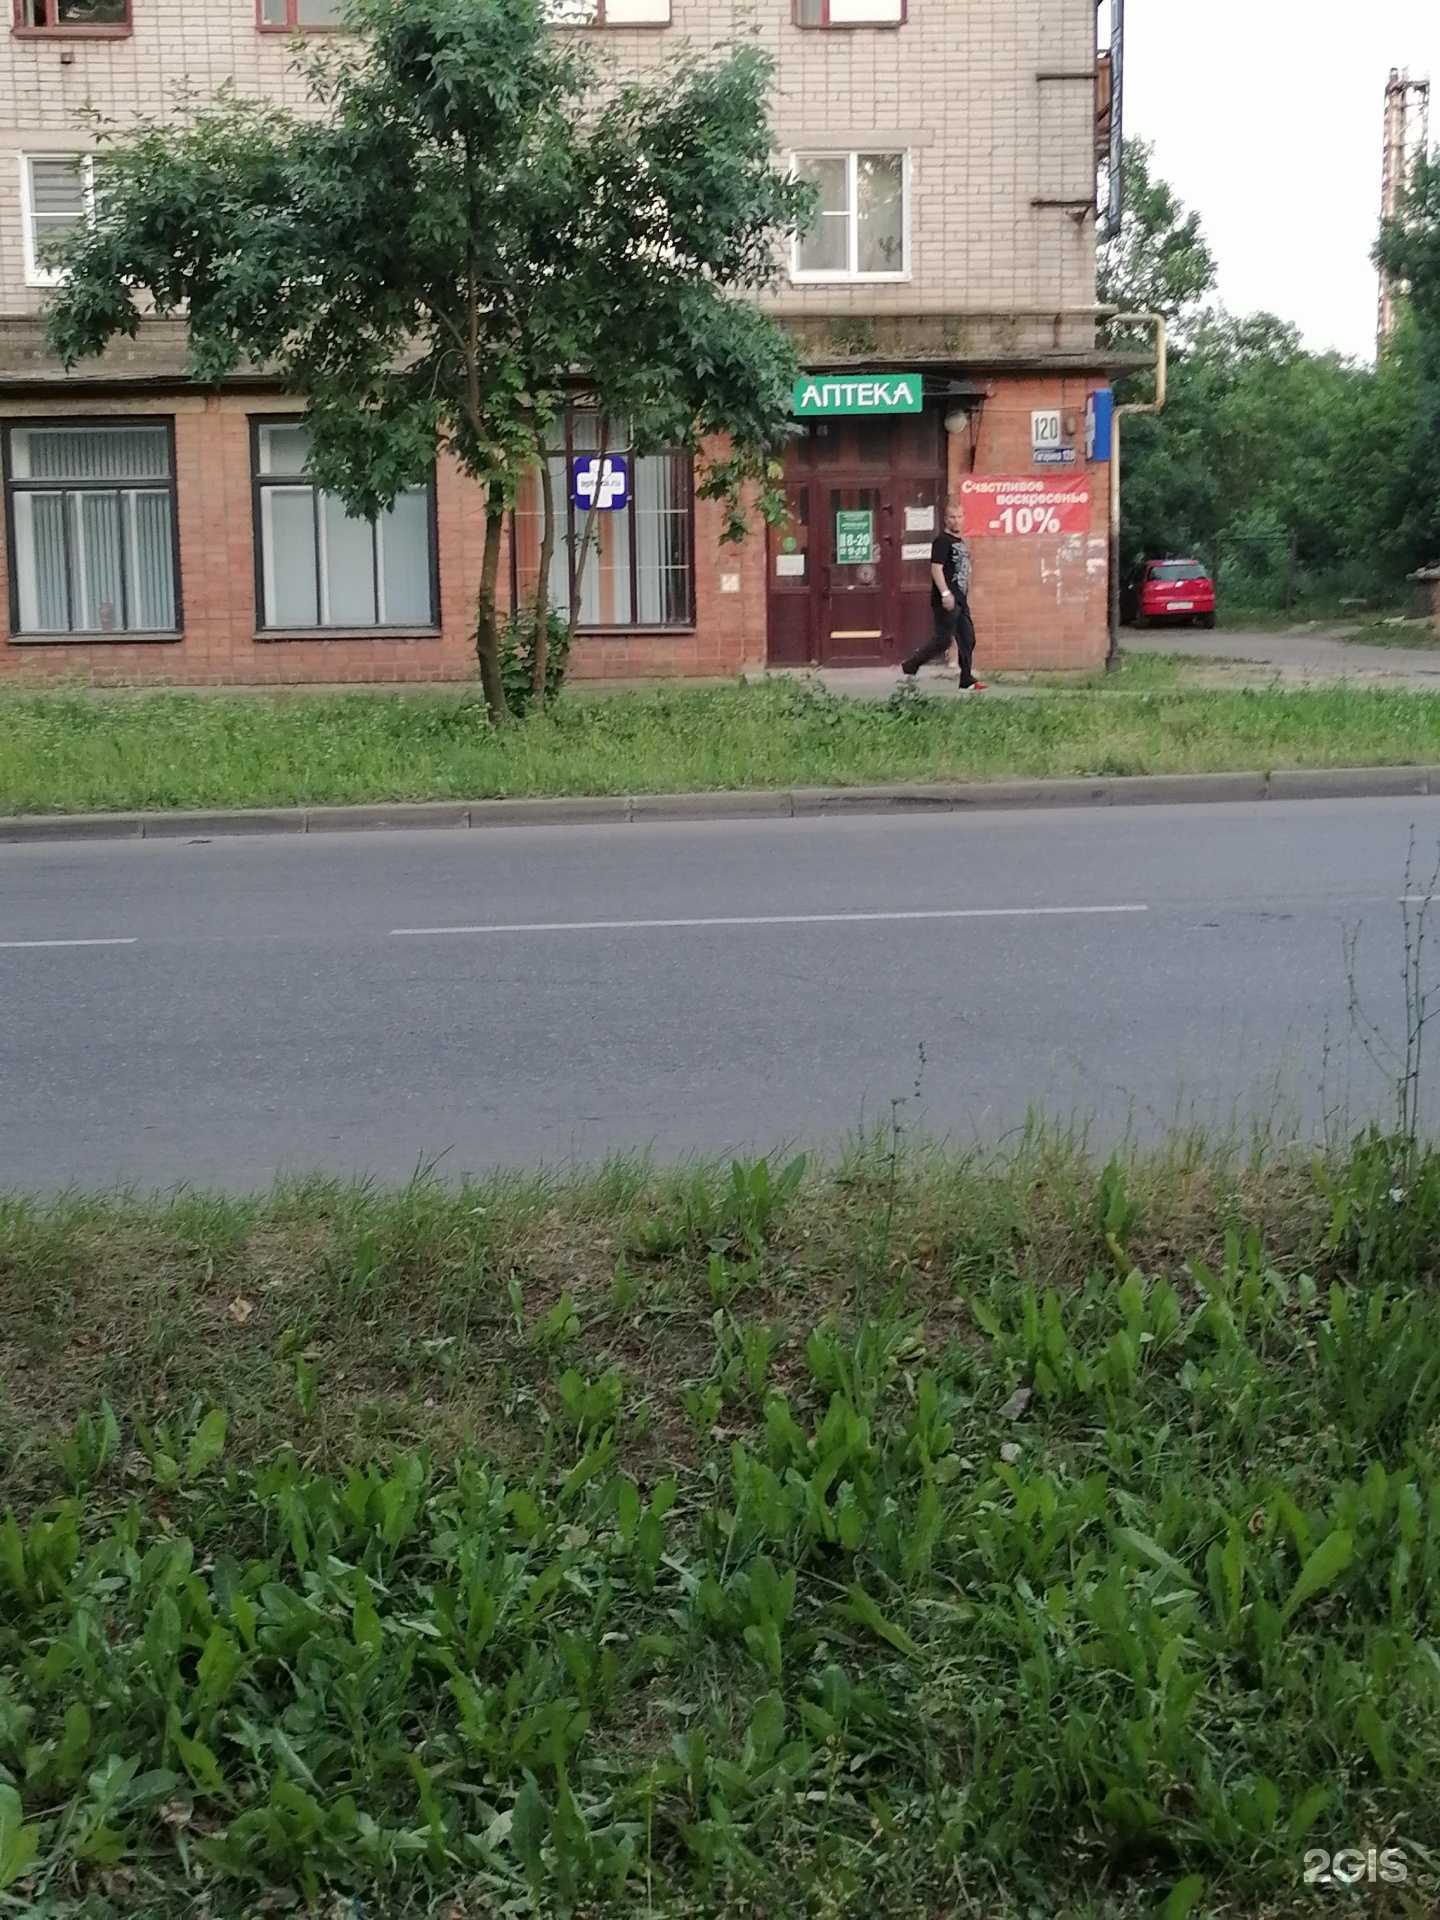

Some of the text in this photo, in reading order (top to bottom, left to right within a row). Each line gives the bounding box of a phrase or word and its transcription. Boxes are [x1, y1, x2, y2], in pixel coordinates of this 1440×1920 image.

[800, 382, 913, 407] АПТЕКА
[1034, 416, 1058, 441] 120
[961, 479, 1044, 494] Счастливое
[995, 492, 1089, 507] воскресенье
[988, 506, 1060, 534] -10%
